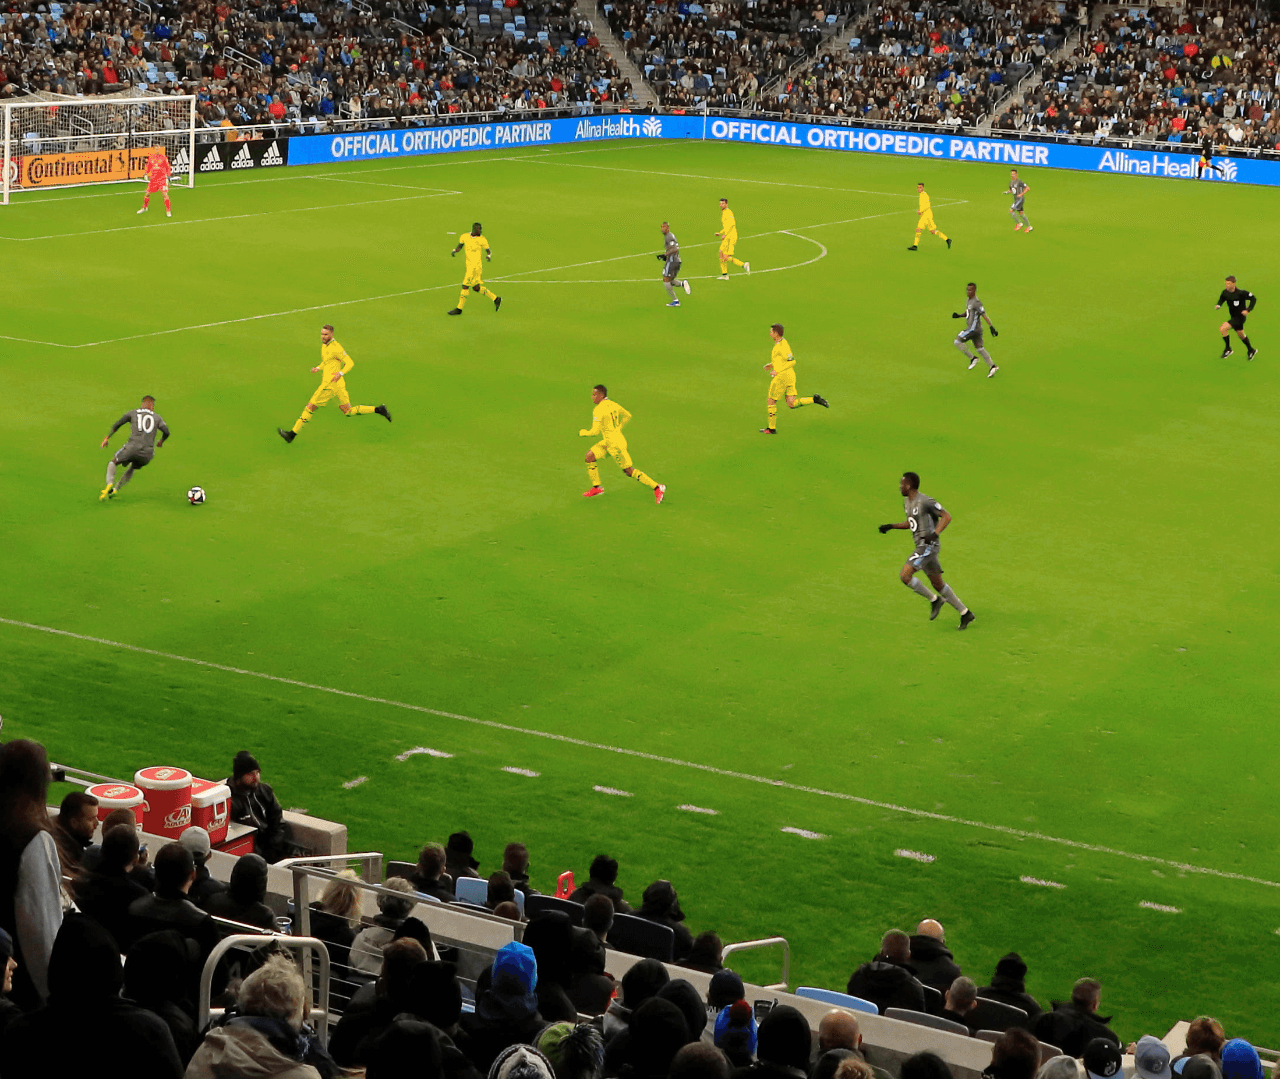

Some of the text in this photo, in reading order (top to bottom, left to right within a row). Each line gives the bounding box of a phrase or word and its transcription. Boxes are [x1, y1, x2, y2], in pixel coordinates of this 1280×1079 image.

[331, 122, 552, 158] OFFICIAL ORTHOPEDIC PARTNER
[711, 120, 1049, 165] OFFICIAL ORTHOPEDIC PARTNER
[27, 153, 113, 184] Continental
[200, 161, 224, 171] adidas
[231, 158, 254, 169] adidas
[260, 156, 283, 166] adidas
[136, 413, 155, 434] 10
